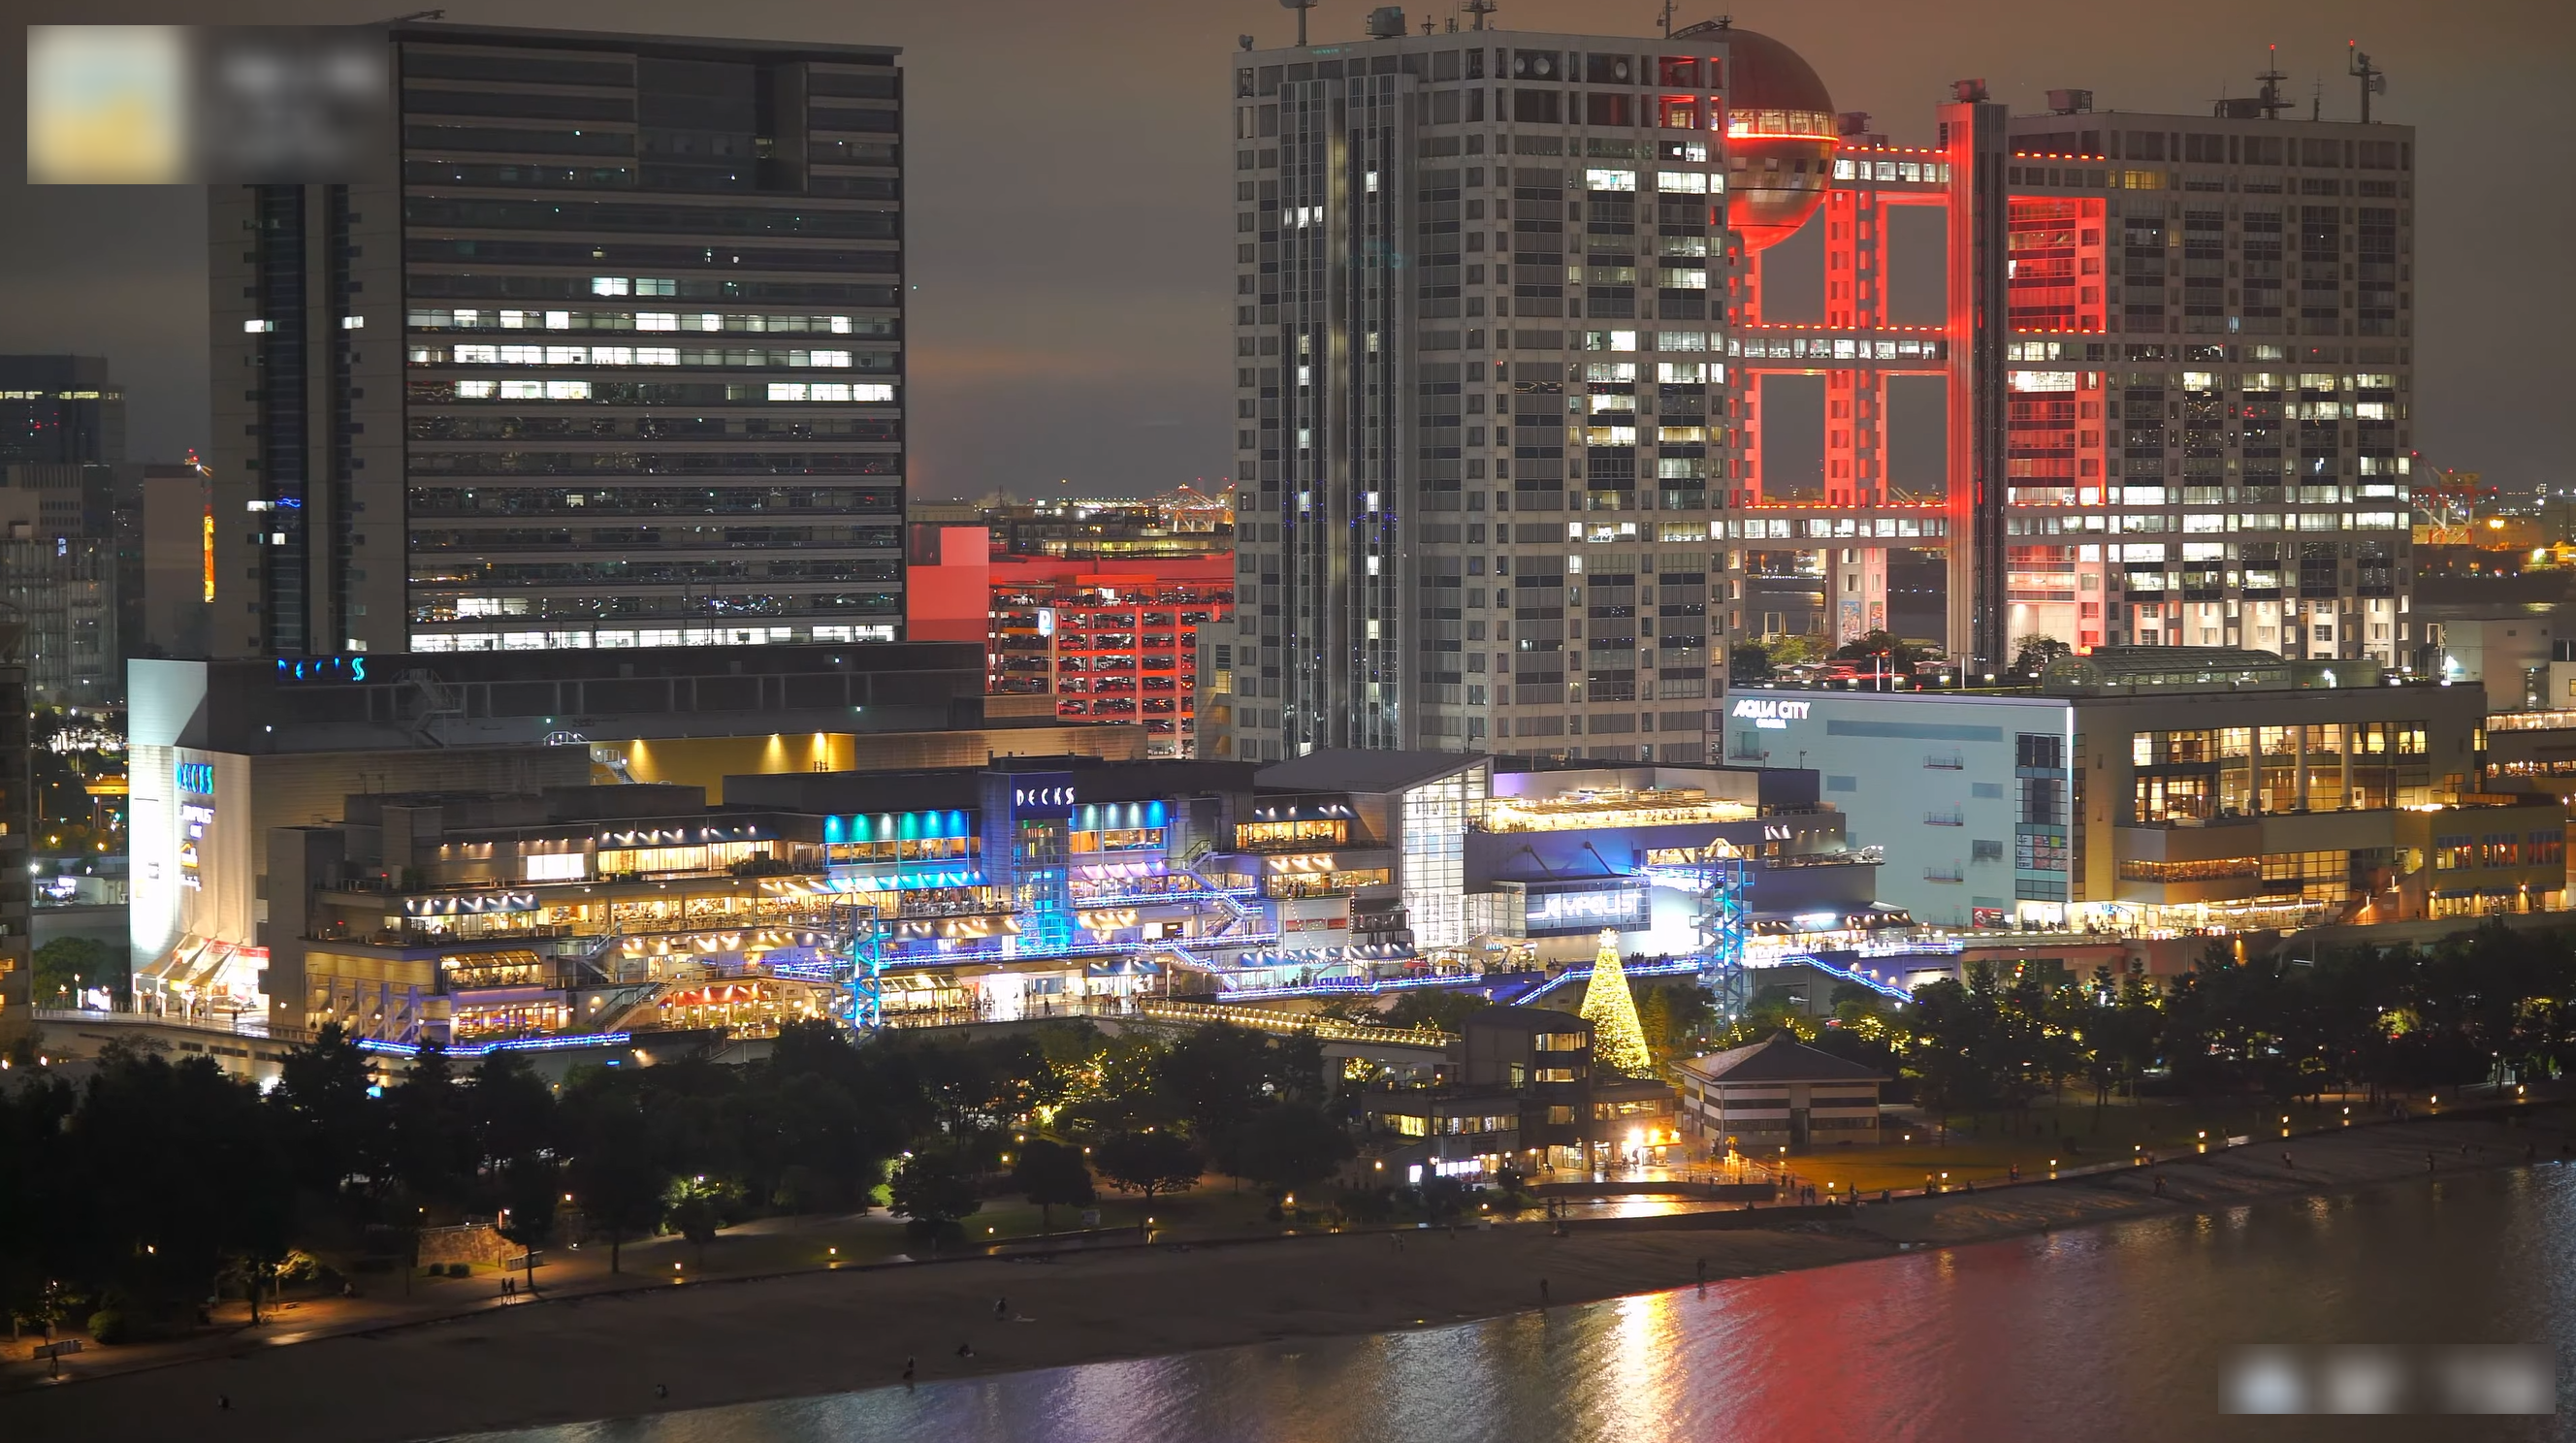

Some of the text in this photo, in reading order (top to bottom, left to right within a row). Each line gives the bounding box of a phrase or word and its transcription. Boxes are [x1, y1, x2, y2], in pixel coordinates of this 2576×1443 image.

[1731, 699, 1811, 720] AQUA CITY
[1016, 786, 1075, 807] DECKS
